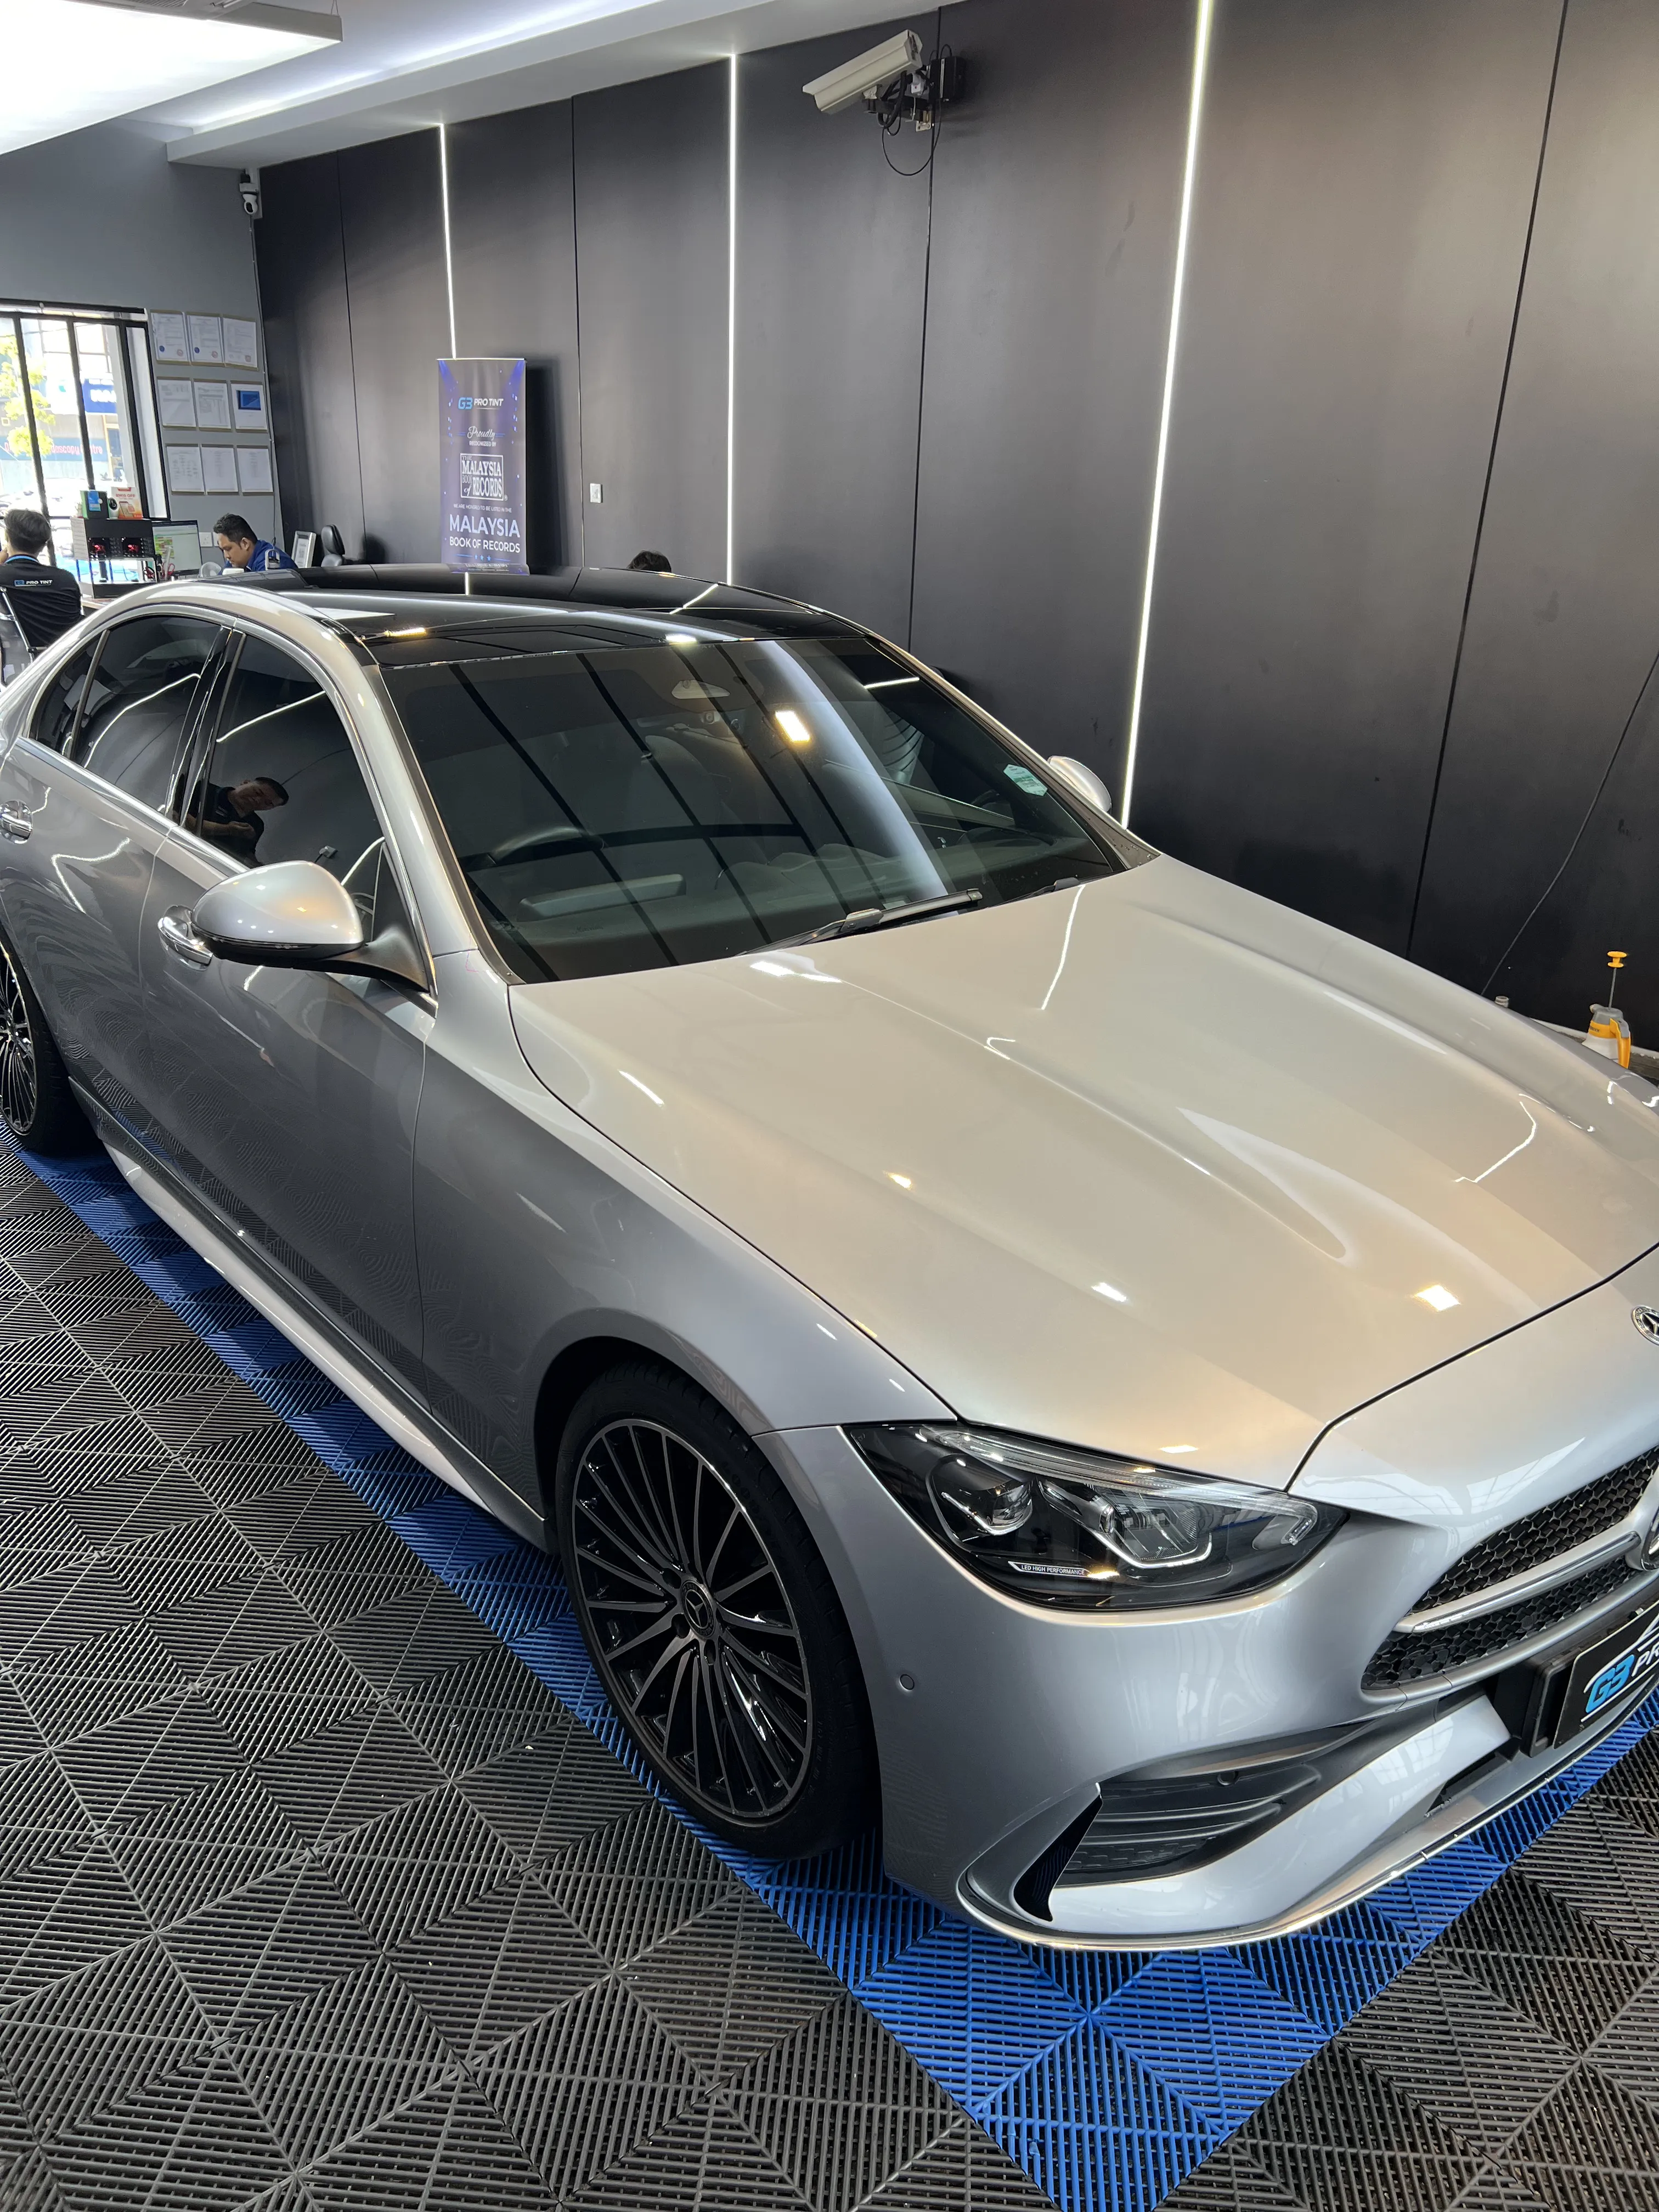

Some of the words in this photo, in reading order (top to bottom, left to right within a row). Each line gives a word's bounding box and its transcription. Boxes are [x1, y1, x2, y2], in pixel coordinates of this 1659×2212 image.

[458, 397, 473, 410] G3
[473, 398, 488, 407] PRO
[489, 398, 504, 407] TINT
[467, 425, 495, 441] Proudly
[52, 445, 80, 455] doscopy
[462, 460, 501, 477] MALAYSIA
[464, 483, 472, 496] of
[472, 477, 502, 498] RECORDS
[450, 514, 521, 538] MALAYSIA
[449, 536, 471, 548] BOOK
[472, 538, 482, 549] OF
[483, 539, 521, 553] RECORDS
[1585, 1654, 1635, 1713] G3
